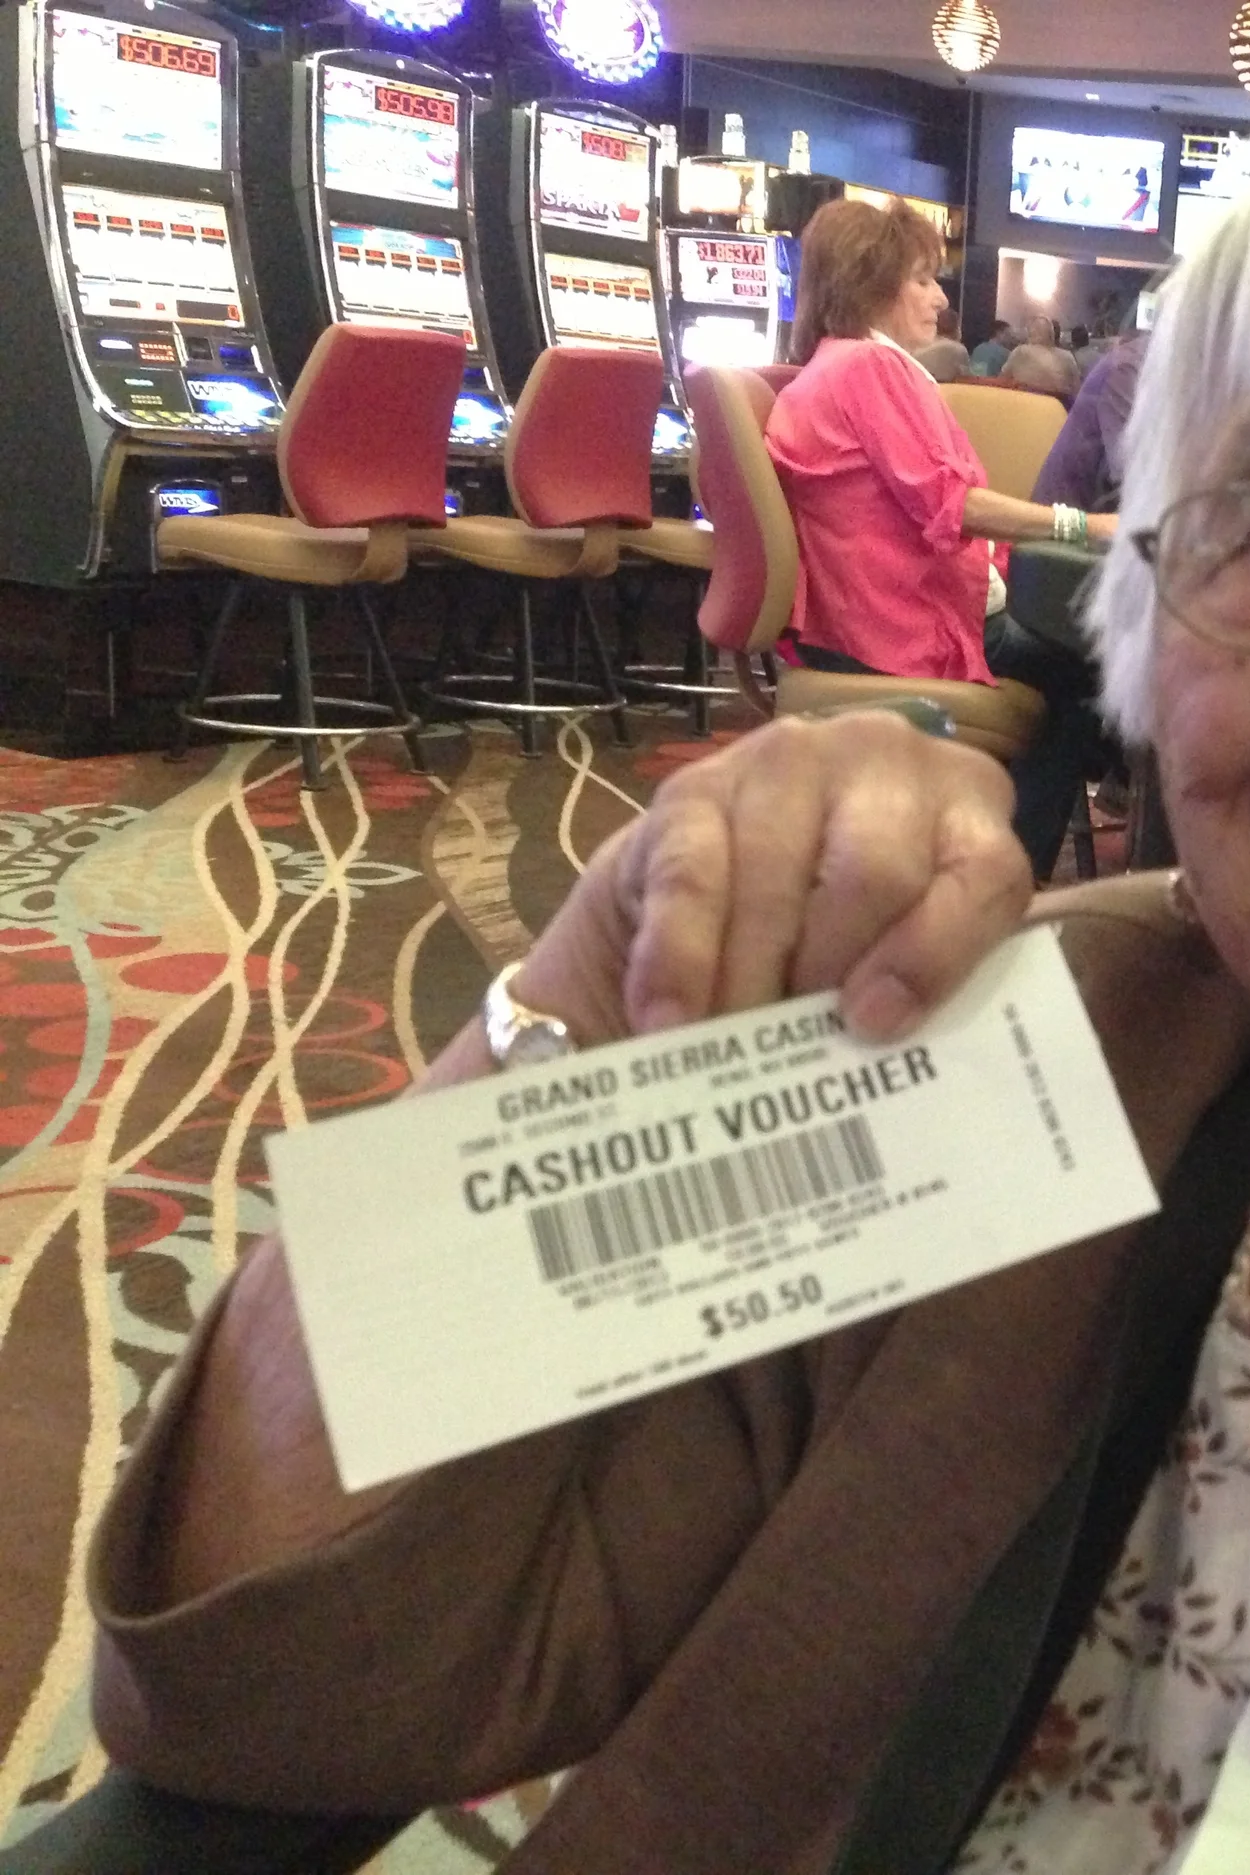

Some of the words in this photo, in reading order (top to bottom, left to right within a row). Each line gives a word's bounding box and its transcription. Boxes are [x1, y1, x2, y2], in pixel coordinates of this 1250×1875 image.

[497, 1066, 620, 1123] GRAND
[630, 1034, 747, 1089] SIERRA
[754, 1009, 847, 1053] CASIN
[462, 1111, 698, 1215] CASHOUT
[714, 1044, 938, 1143] VOUCHER
[699, 1272, 823, 1339] $50.50
